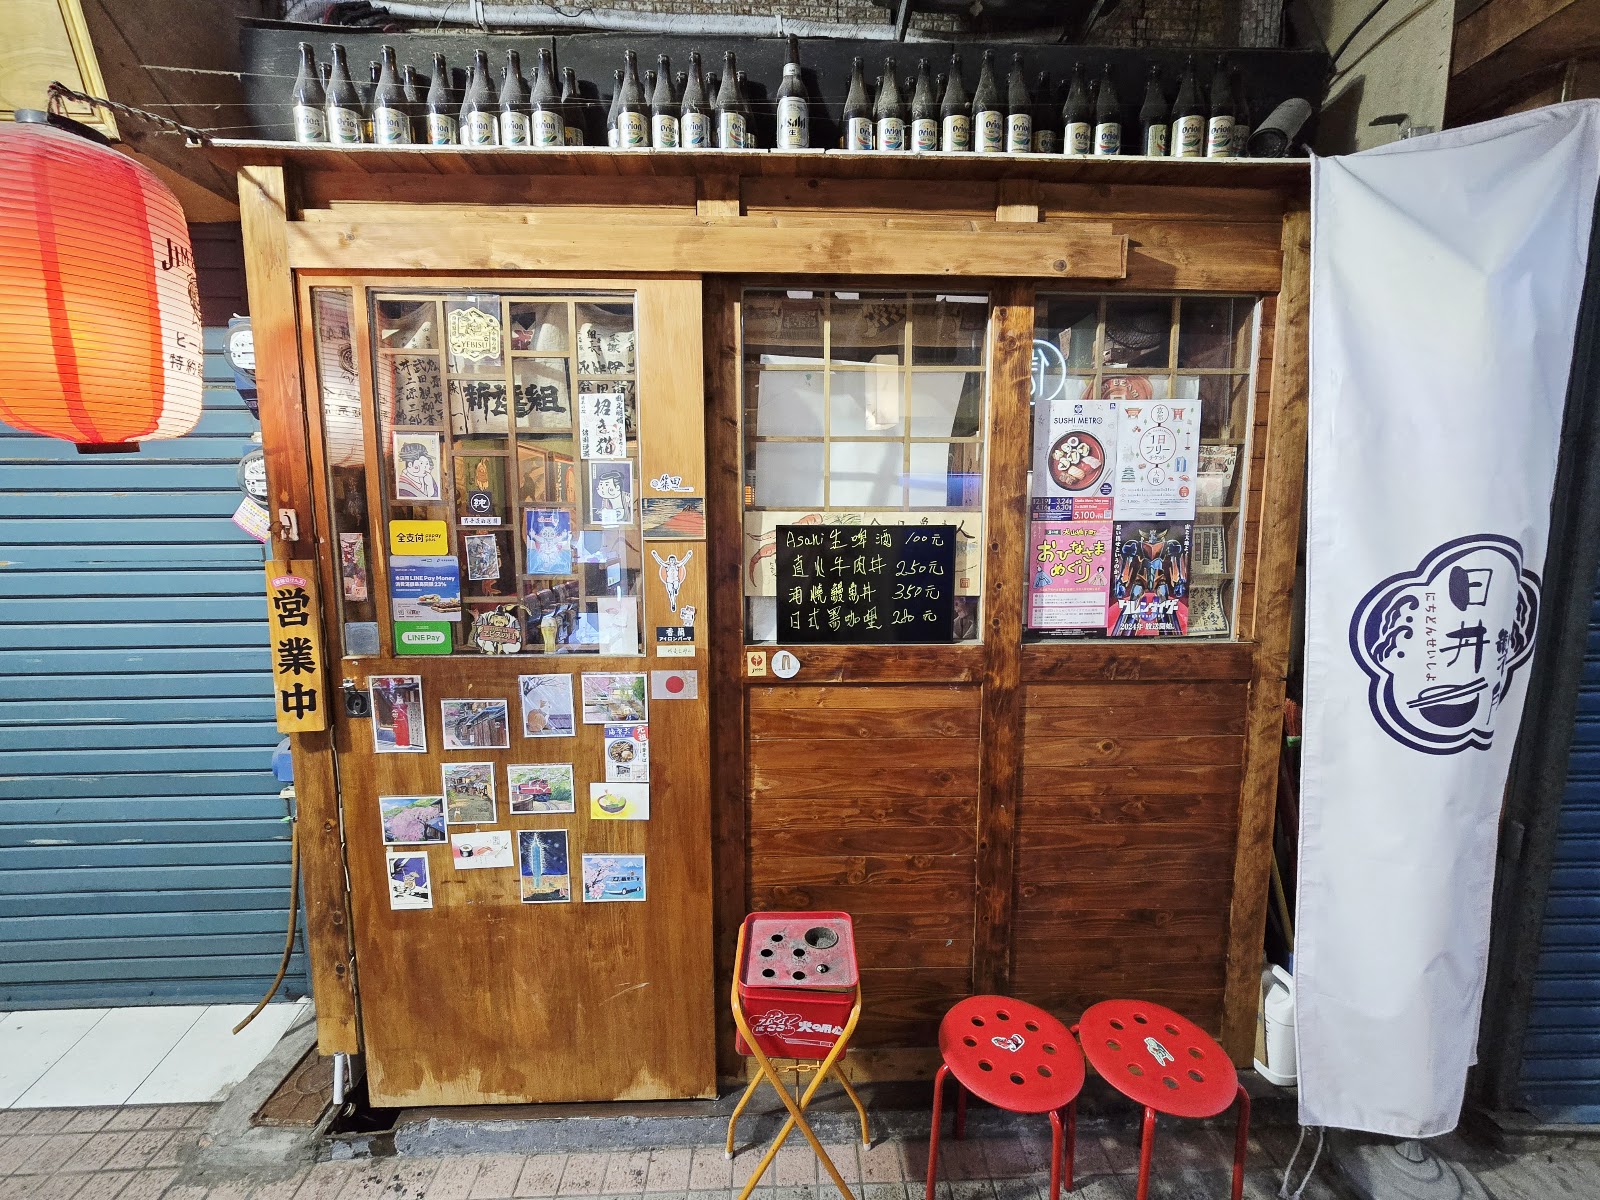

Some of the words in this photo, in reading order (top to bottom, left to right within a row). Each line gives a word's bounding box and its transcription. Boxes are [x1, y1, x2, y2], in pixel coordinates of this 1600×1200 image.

[461, 341, 488, 349] YEBISU
[1078, 416, 1103, 425] METRO
[1151, 434, 1166, 445] 1日
[1146, 445, 1170, 455] フリー
[396, 532, 424, 543] 全支付
[1037, 540, 1106, 563] おひなさま
[895, 560, 944, 576] 250元
[1050, 559, 1091, 584] めぐり
[892, 584, 940, 600] 350元
[427, 634, 440, 643] Pay
[273, 587, 317, 720] 営業中
